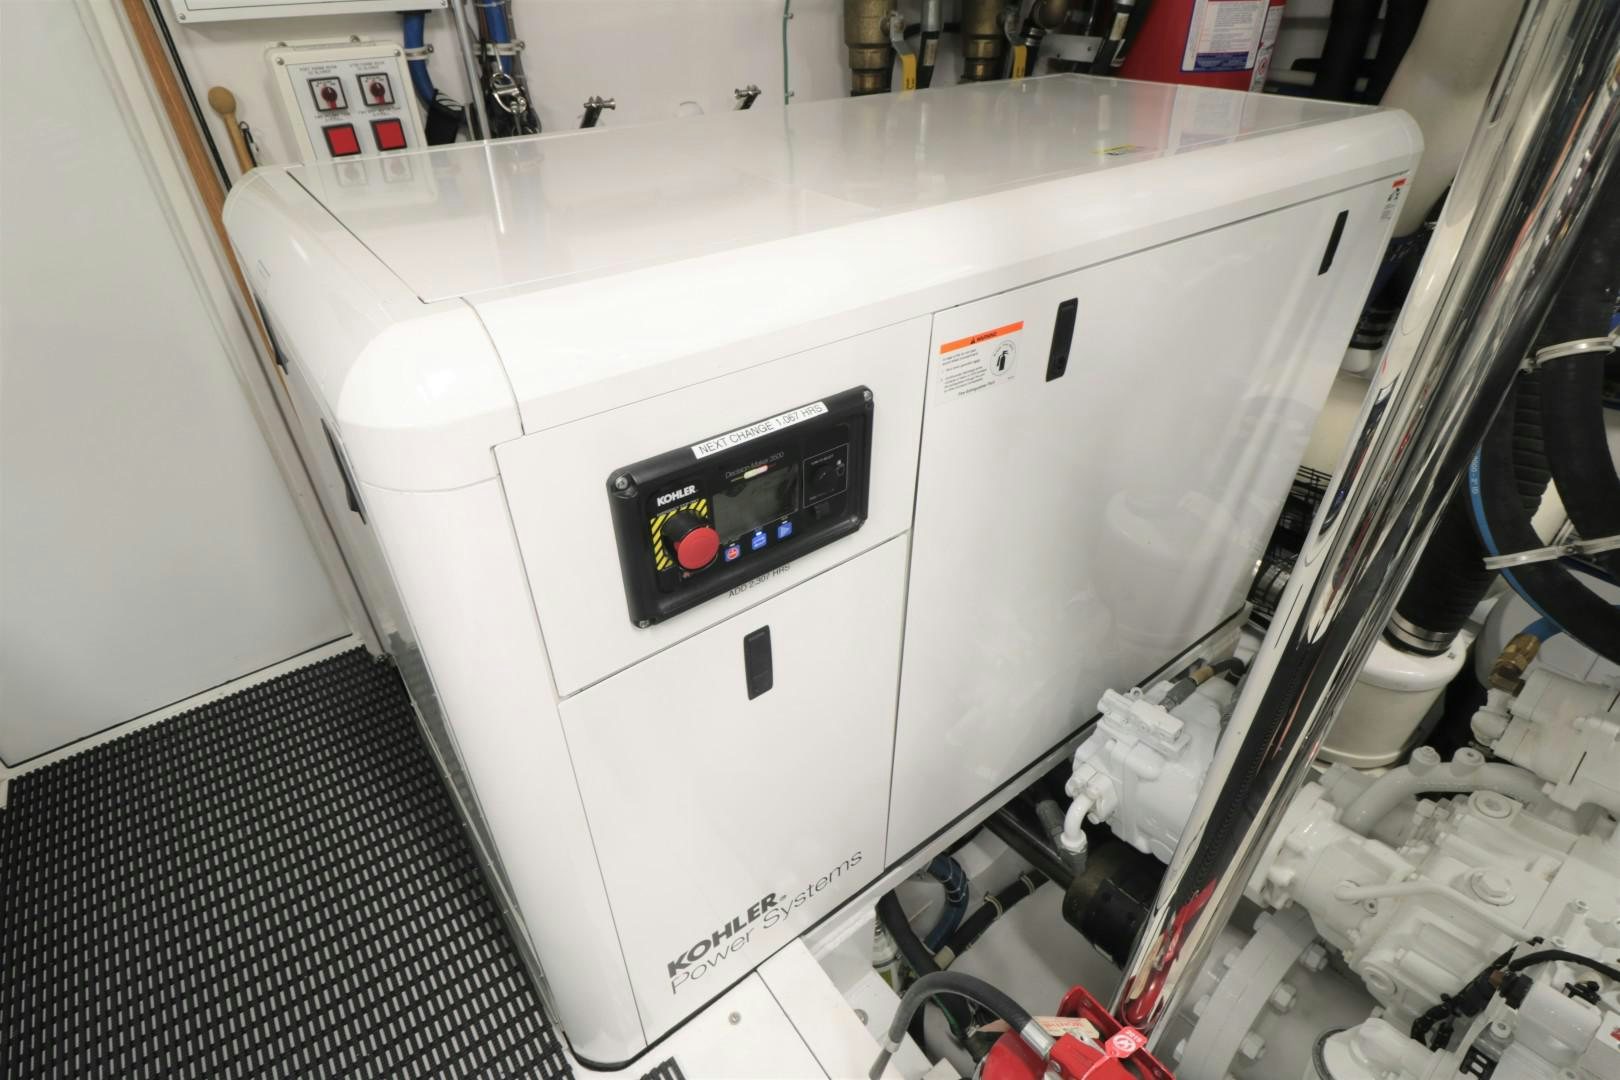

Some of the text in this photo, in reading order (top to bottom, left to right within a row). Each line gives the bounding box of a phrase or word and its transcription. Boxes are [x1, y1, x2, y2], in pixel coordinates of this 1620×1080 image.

[699, 437, 727, 455] NEXT
[729, 421, 775, 443] CHANGE
[801, 405, 823, 418] HRS
[657, 484, 697, 507] KOHLER
[667, 892, 777, 978] KOHLER
[671, 850, 864, 994] Power Systems
